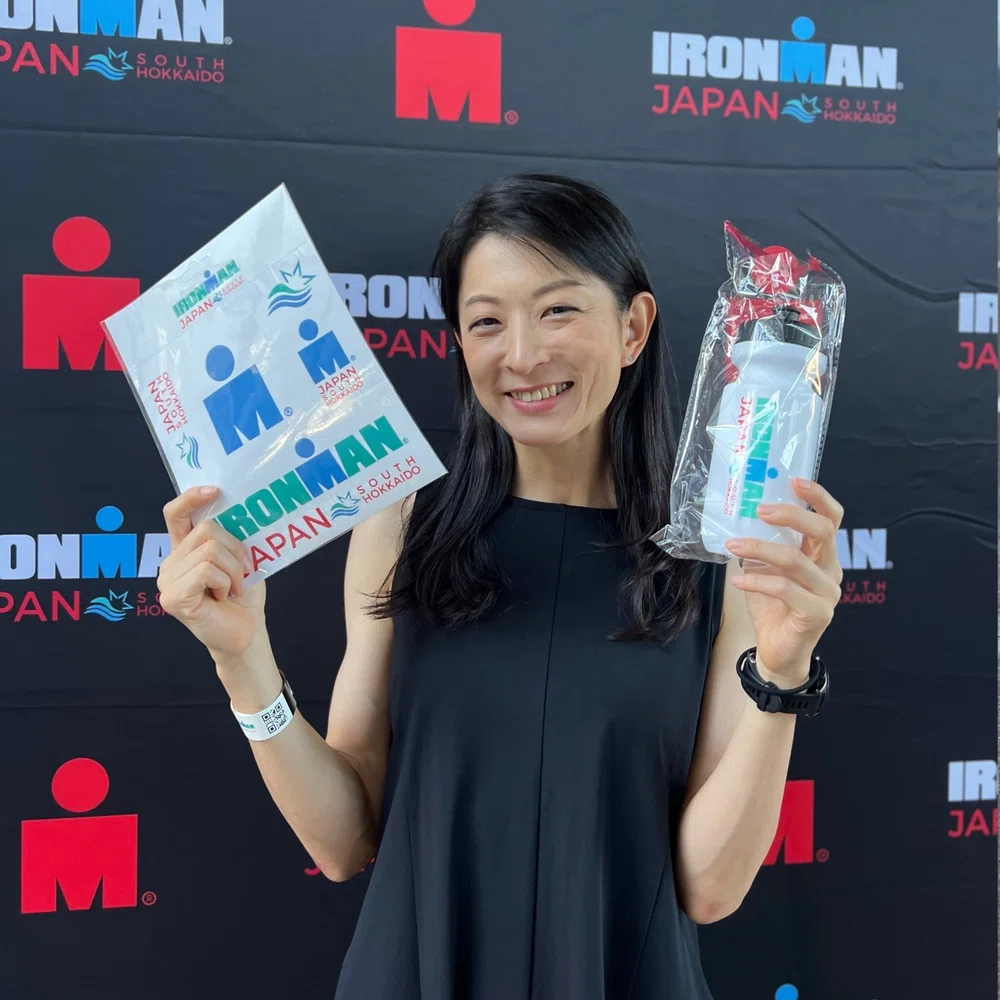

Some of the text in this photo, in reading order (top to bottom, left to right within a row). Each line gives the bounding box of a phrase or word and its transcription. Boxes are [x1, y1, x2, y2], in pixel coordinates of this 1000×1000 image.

[136, 53, 224, 70] SOUTH
[652, 16, 898, 90] IRONMAN
[136, 67, 224, 83] HOKKAIDO
[652, 85, 779, 121] JAPAN
[824, 98, 897, 113] SOUTH
[824, 111, 897, 125] HOKKAIDO
[172, 259, 239, 318] IRONMAN
[179, 298, 213, 330] JAPAN
[162, 372, 188, 425] HOKKAIDO
[318, 366, 356, 395] JAPAN
[322, 376, 360, 401] SOUTH
[326, 381, 364, 407] HOKKAIDO
[148, 381, 176, 434] JAPAN
[156, 376, 183, 429] SOUTH
[212, 415, 404, 542] RONMAN
[356, 456, 416, 495] SOUTH
[362, 465, 421, 504] HOKKAIDO
